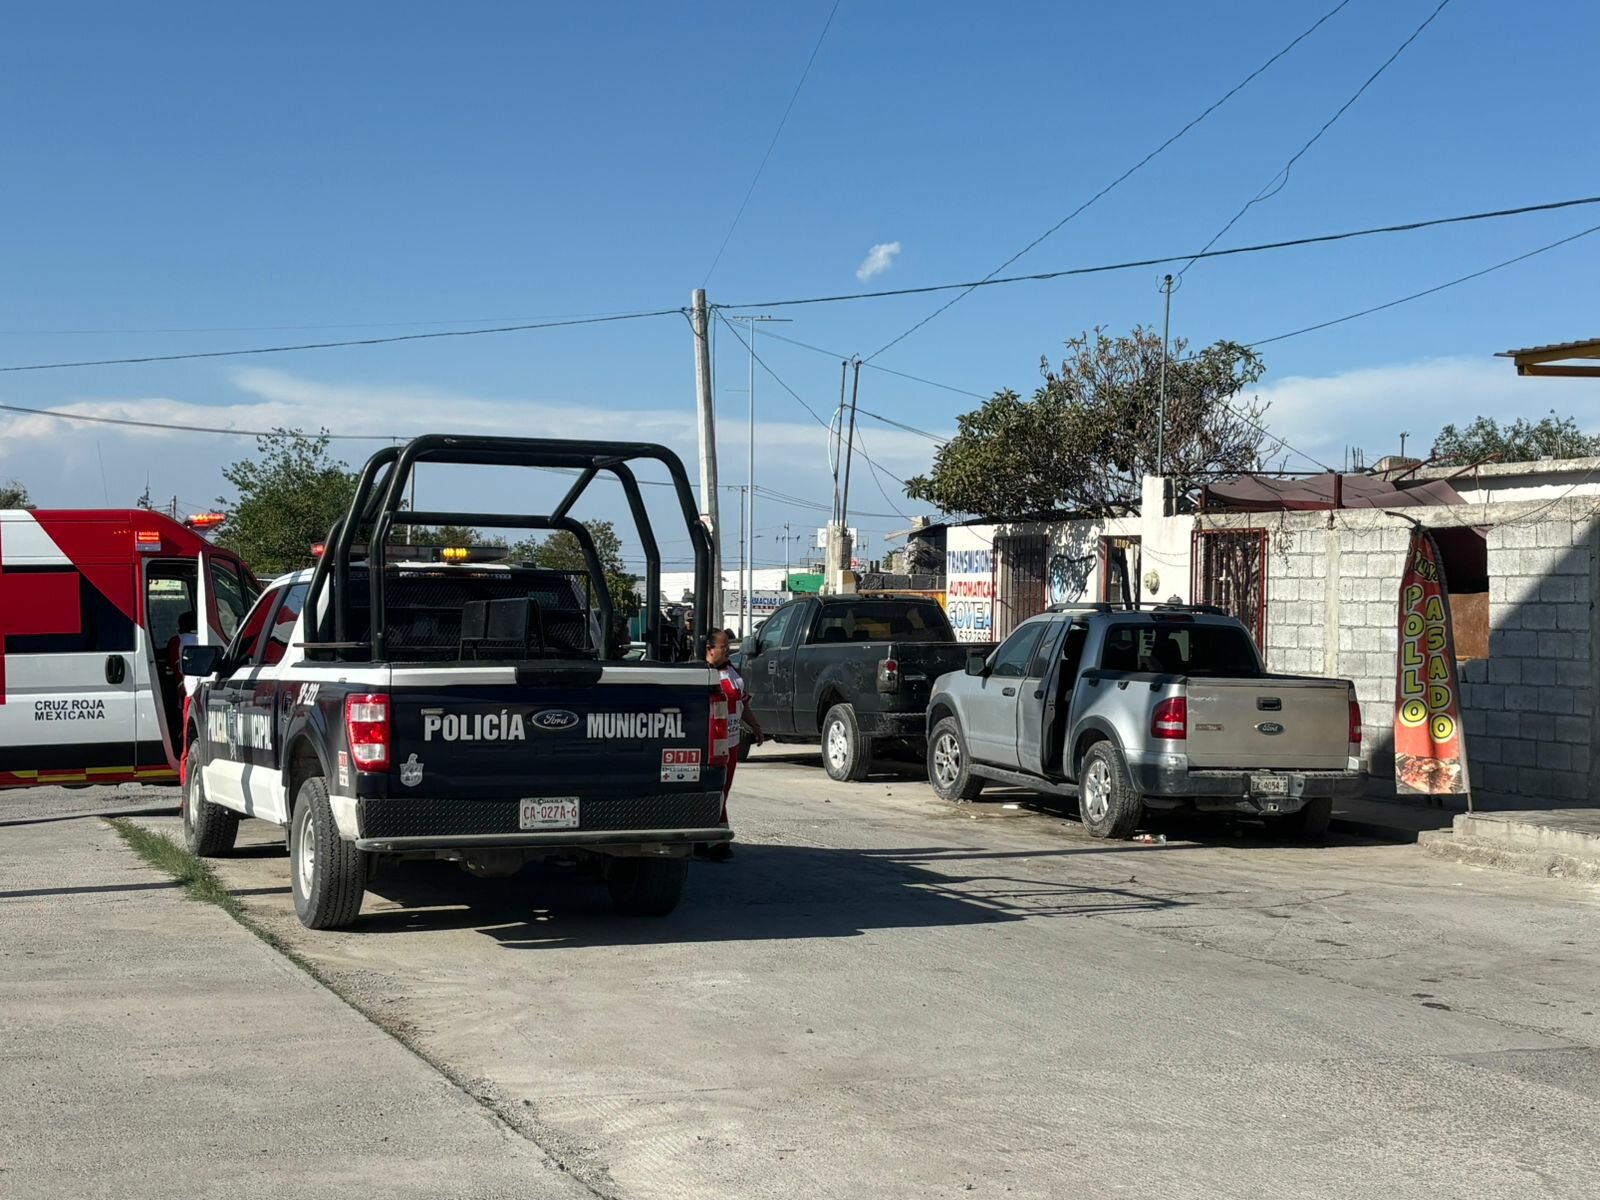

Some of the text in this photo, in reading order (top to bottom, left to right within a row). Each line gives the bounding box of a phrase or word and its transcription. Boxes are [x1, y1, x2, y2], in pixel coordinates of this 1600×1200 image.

[947, 601, 992, 630] GOVEA
[1402, 584, 1428, 728] POLLO
[1425, 595, 1456, 743] ASADO
[34, 699, 105, 711] CRUZ ROJA
[34, 710, 106, 721] MEXICANA
[542, 712, 570, 725] Ford
[423, 709, 686, 741] POLICÍA MUNICIPAL
[664, 751, 697, 763] 911
[523, 805, 577, 821] CA-027A-6
